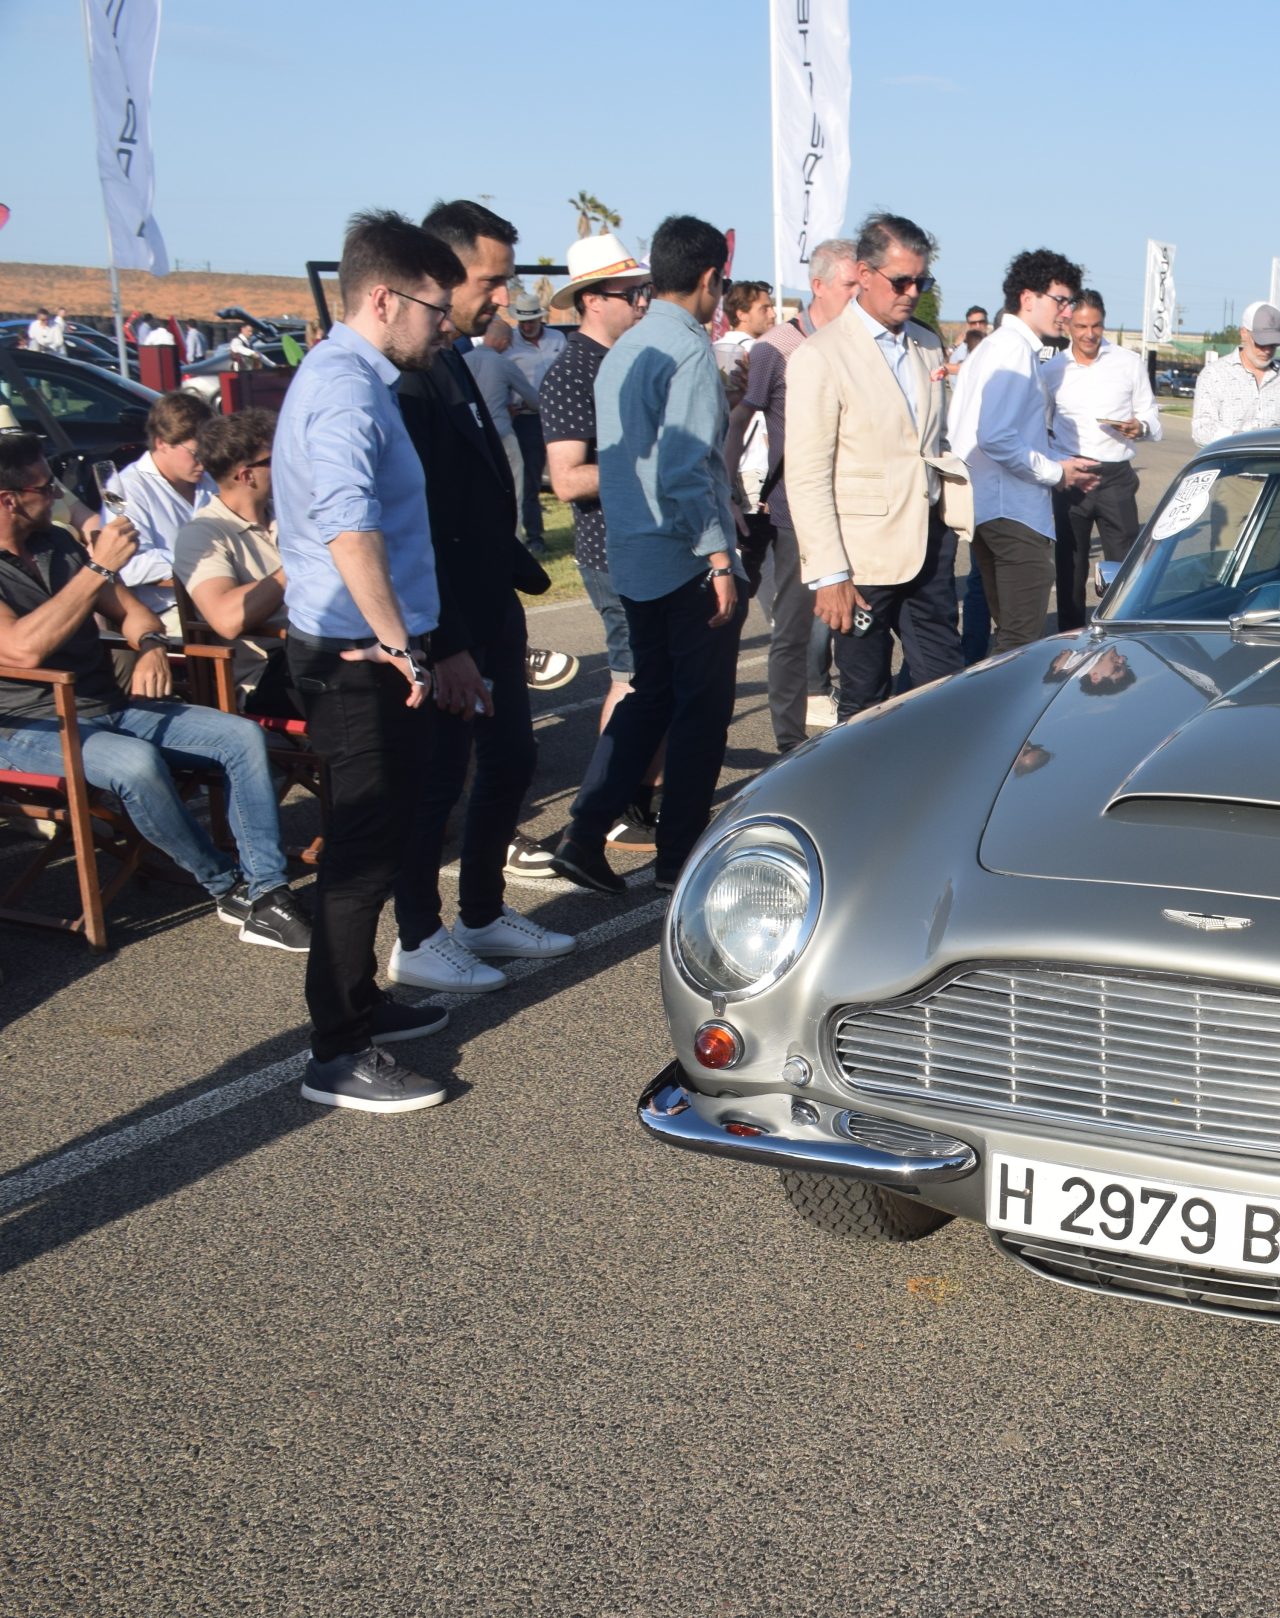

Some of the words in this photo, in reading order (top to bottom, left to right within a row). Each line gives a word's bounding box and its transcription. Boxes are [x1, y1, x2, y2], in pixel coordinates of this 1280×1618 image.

[1184, 473, 1212, 488] TAG
[999, 1162, 1035, 1225] H
[1059, 1176, 1217, 1255] 2979
